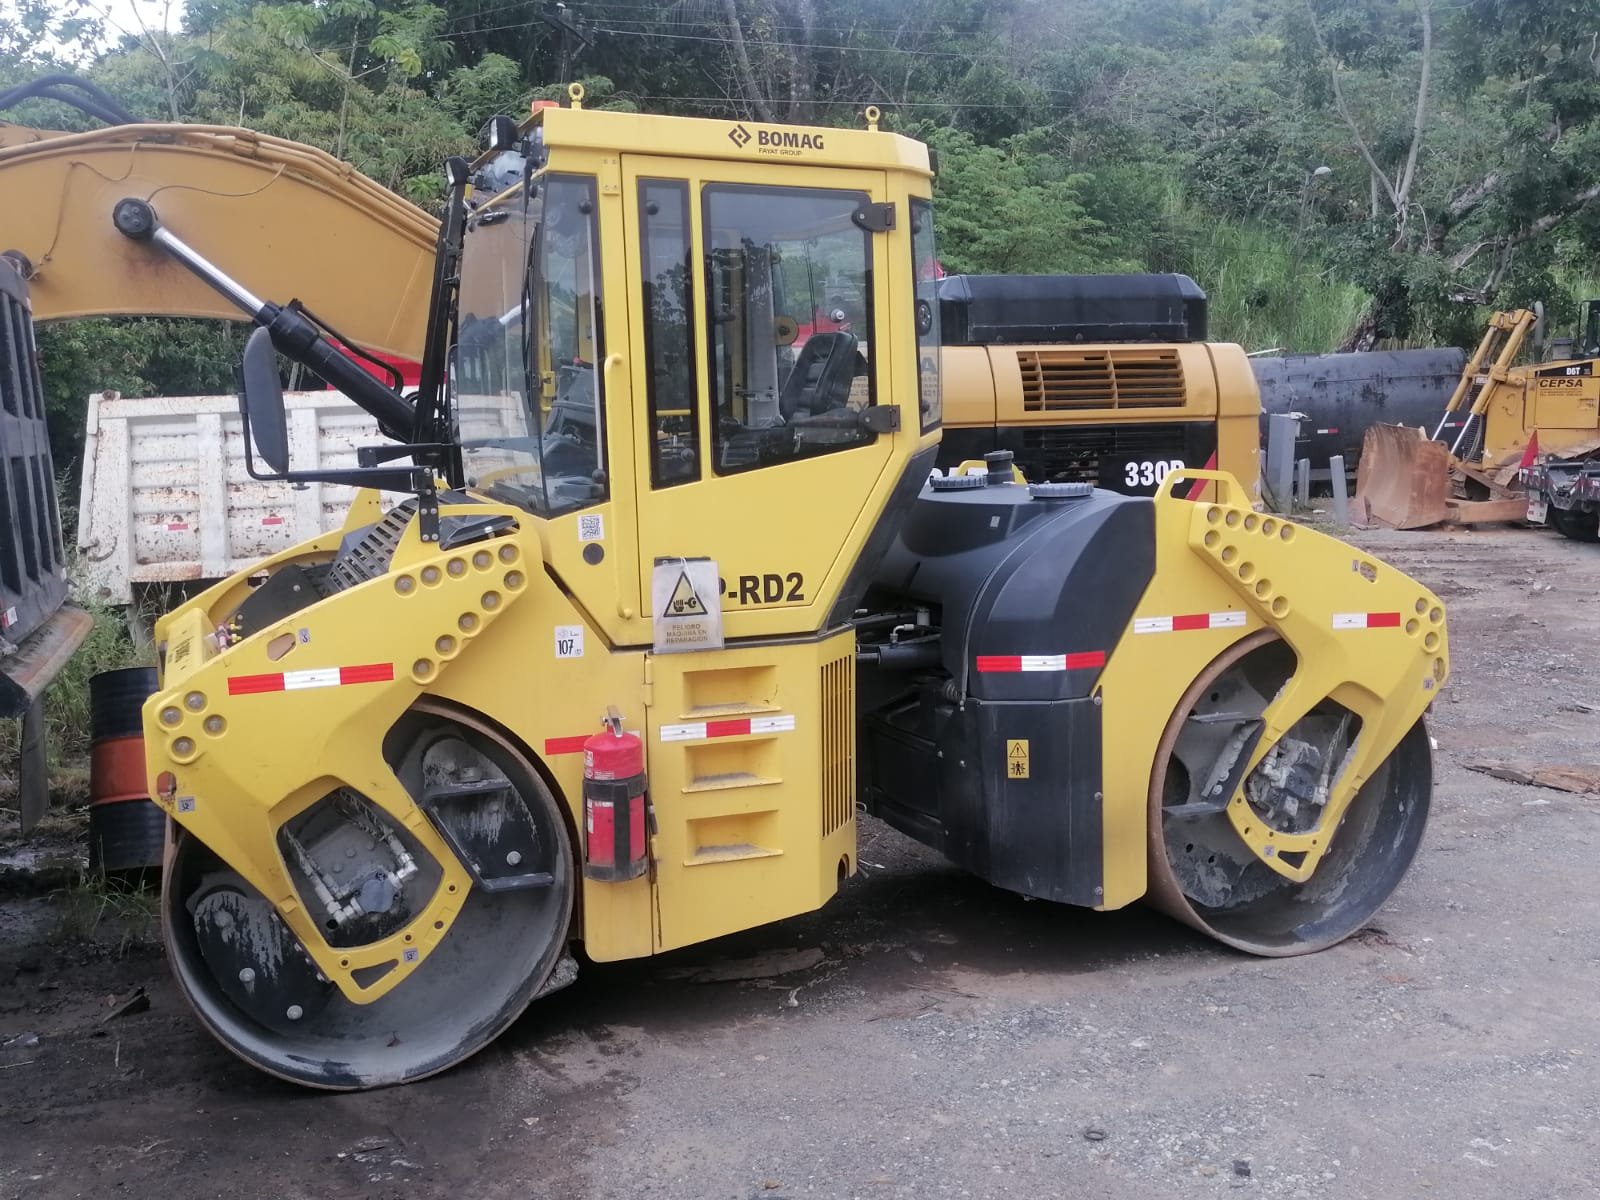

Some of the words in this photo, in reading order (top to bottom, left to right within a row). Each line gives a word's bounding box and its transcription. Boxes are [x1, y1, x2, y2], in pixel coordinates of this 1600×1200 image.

[758, 130, 824, 150] BOMAG
[1540, 379, 1583, 388] CEPSA
[558, 639, 574, 655] 107
